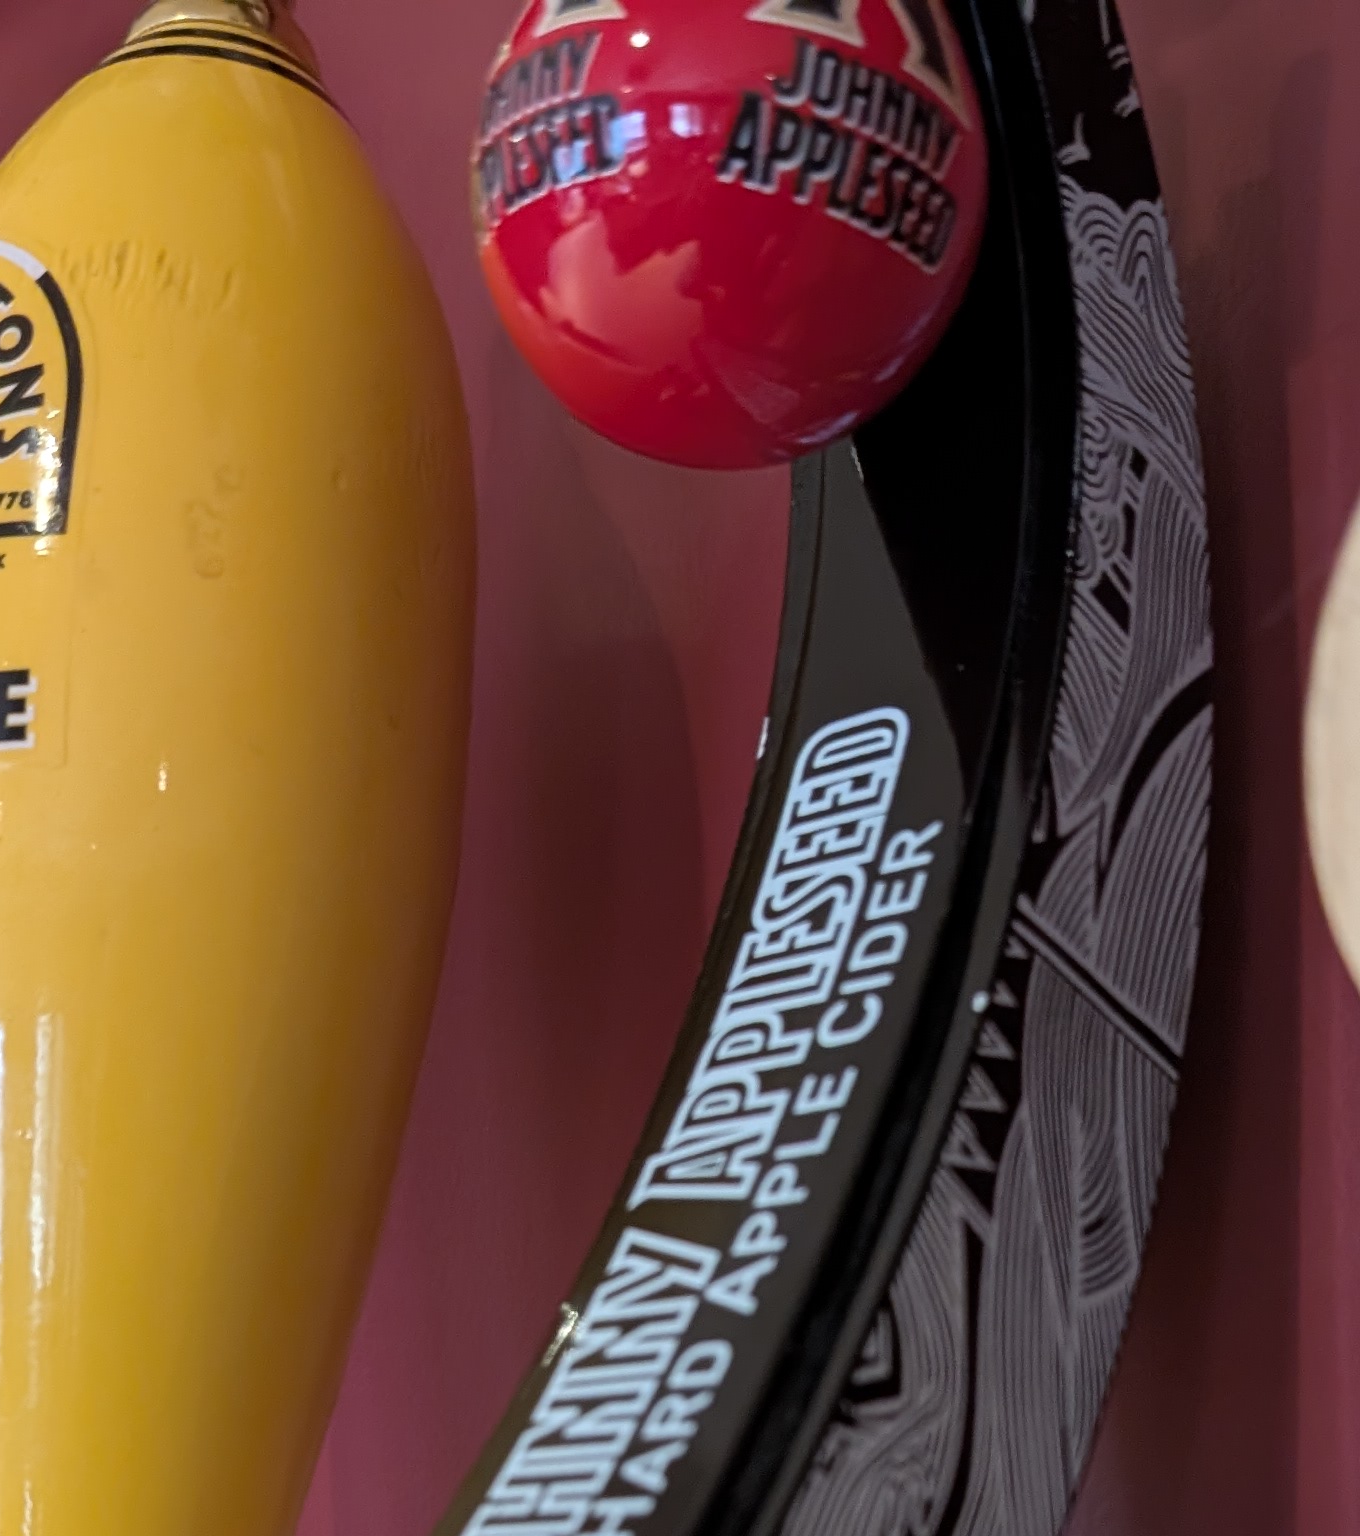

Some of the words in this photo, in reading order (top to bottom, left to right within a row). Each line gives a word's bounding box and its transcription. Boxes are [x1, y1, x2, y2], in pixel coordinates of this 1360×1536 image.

[716, 91, 957, 275] APPLESEED
[773, 36, 962, 181] JOHNNY
[627, 706, 909, 1210] APPLESEED
[707, 1067, 859, 1313] APPLE
[818, 822, 943, 1047] CIDER
